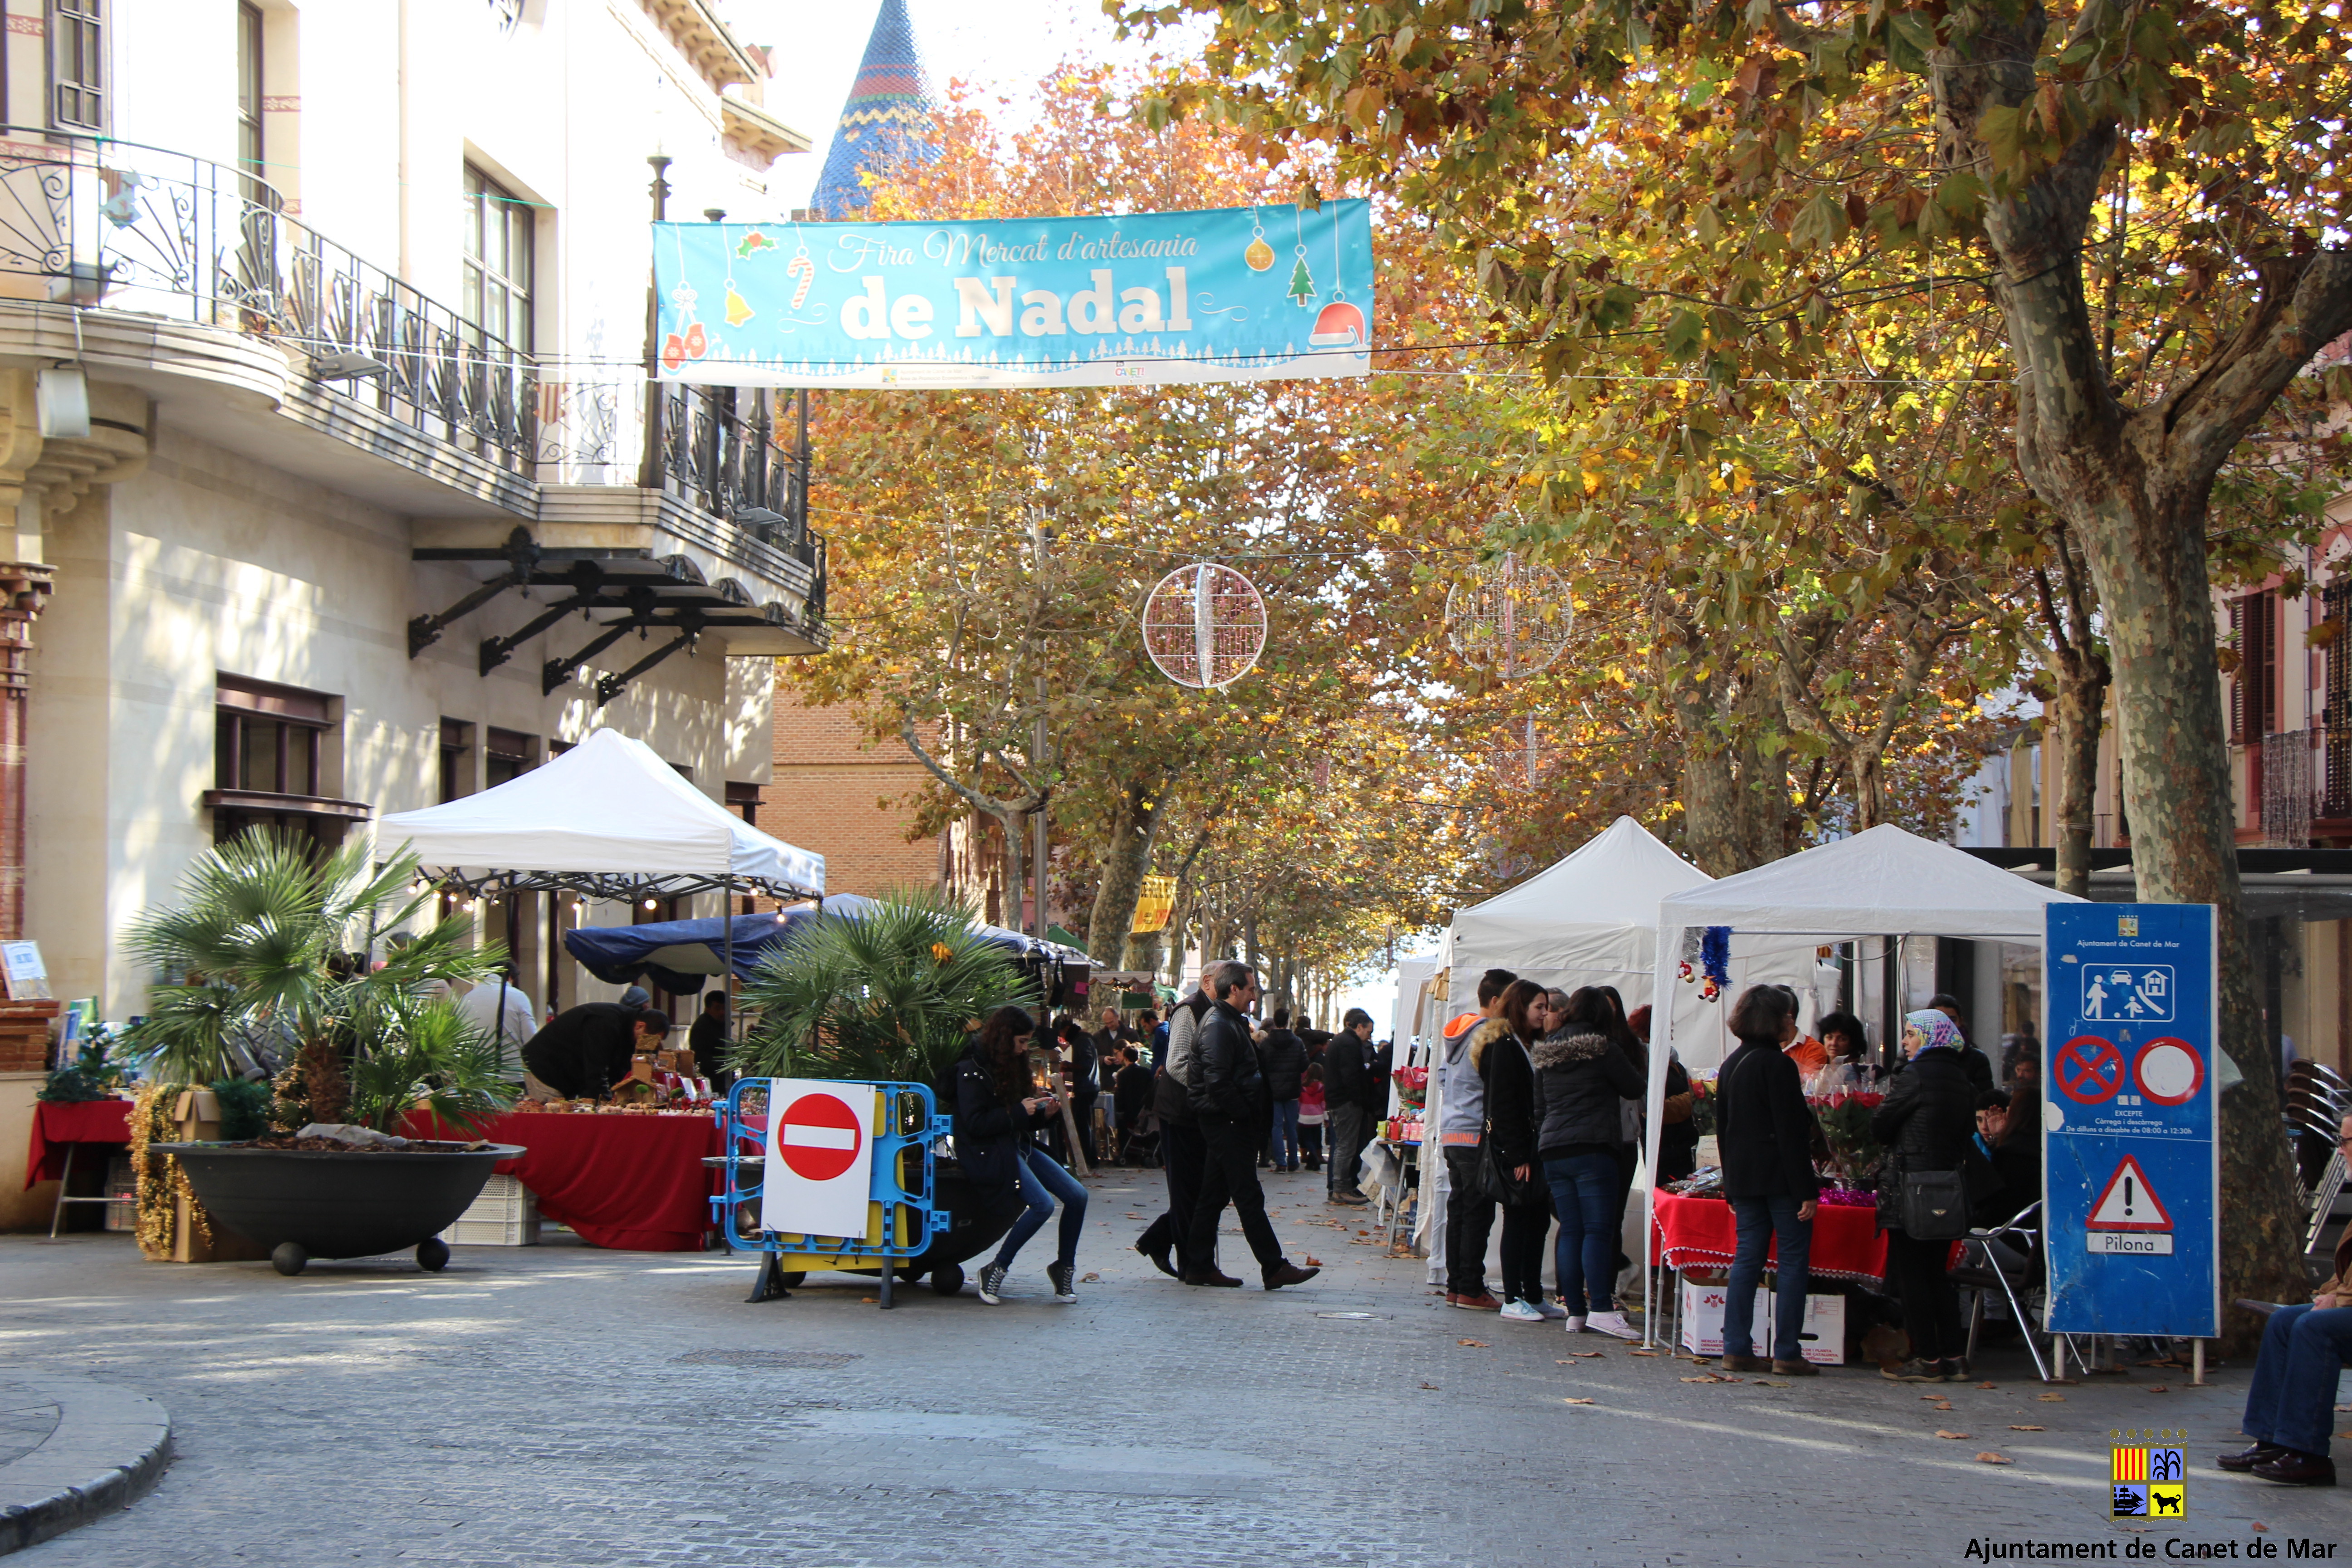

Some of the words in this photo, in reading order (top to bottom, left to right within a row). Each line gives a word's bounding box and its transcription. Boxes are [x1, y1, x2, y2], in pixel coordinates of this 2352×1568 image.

[828, 234, 916, 272] Fira
[923, 229, 1049, 268] Mercat
[1058, 231, 1199, 260] d'artesania
[841, 275, 935, 340] de
[954, 266, 1192, 337] Nadal
[1115, 367, 1144, 376] CANET!
[2077, 940, 2117, 948] Ajuntament
[2095, 1118, 2122, 1126] Càrrega
[2106, 1235, 2154, 1251] Pilona
